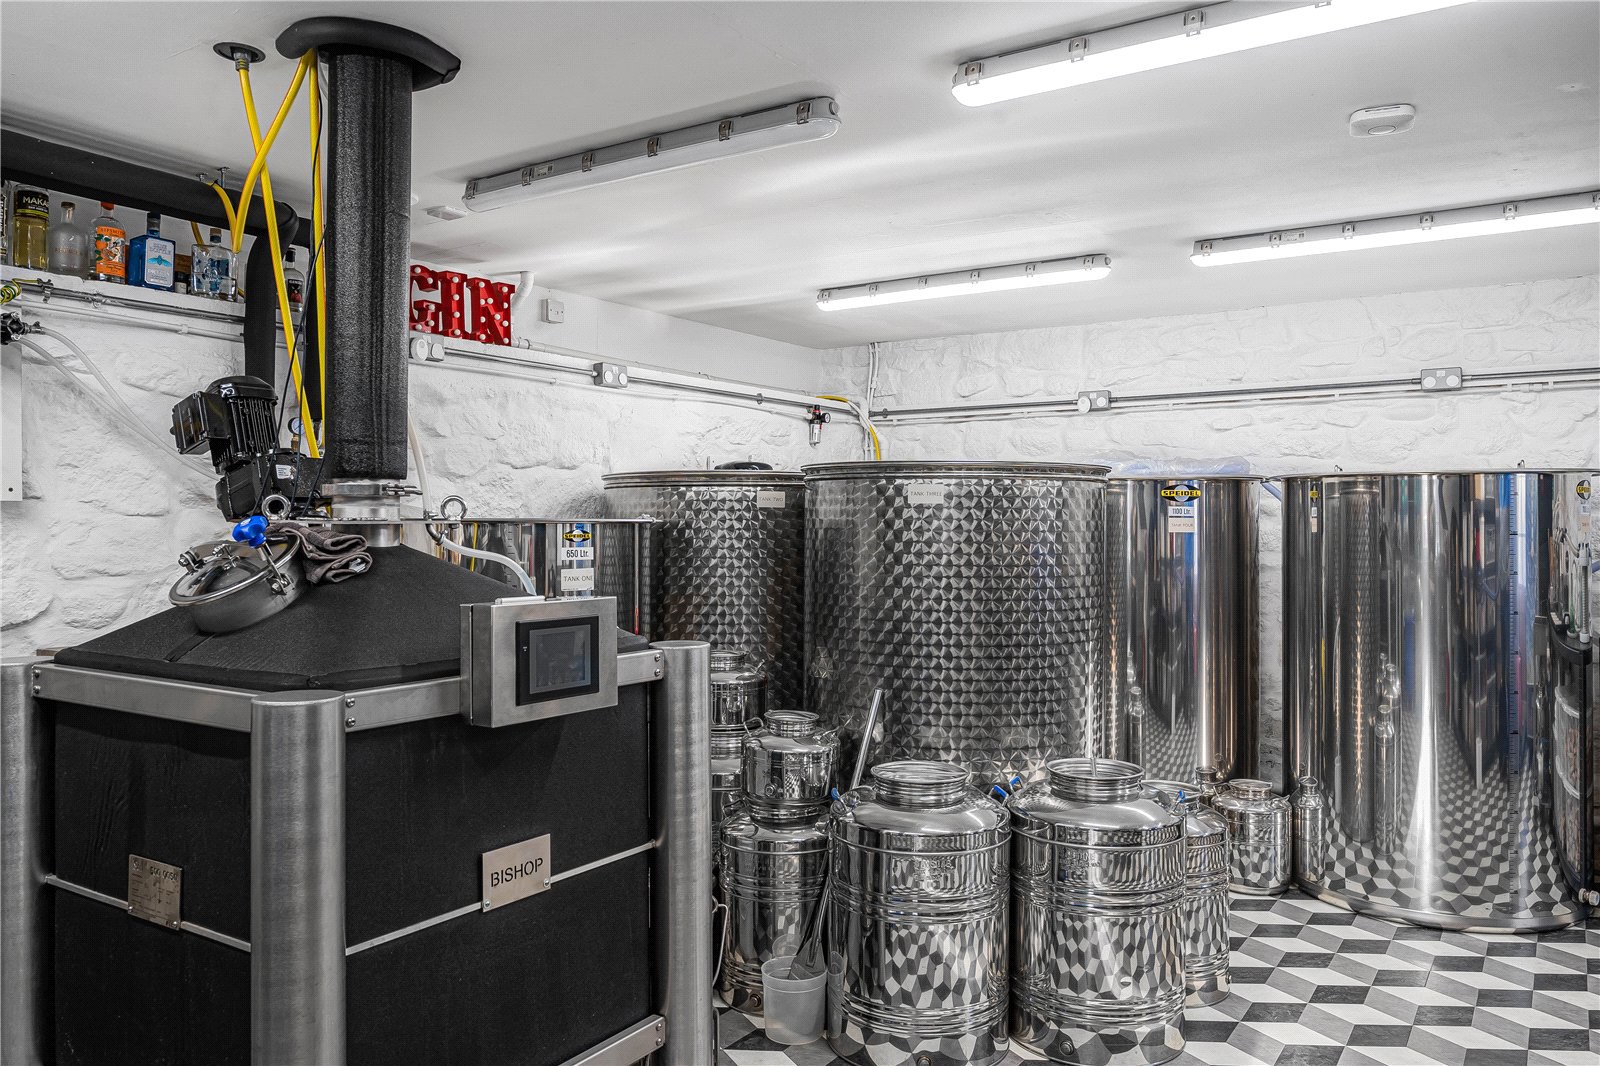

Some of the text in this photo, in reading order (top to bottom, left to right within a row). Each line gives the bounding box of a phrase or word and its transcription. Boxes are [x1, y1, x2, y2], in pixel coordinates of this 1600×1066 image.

[409, 265, 515, 347] GIN
[566, 549, 579, 558] 650
[490, 857, 544, 888] BISHOP
